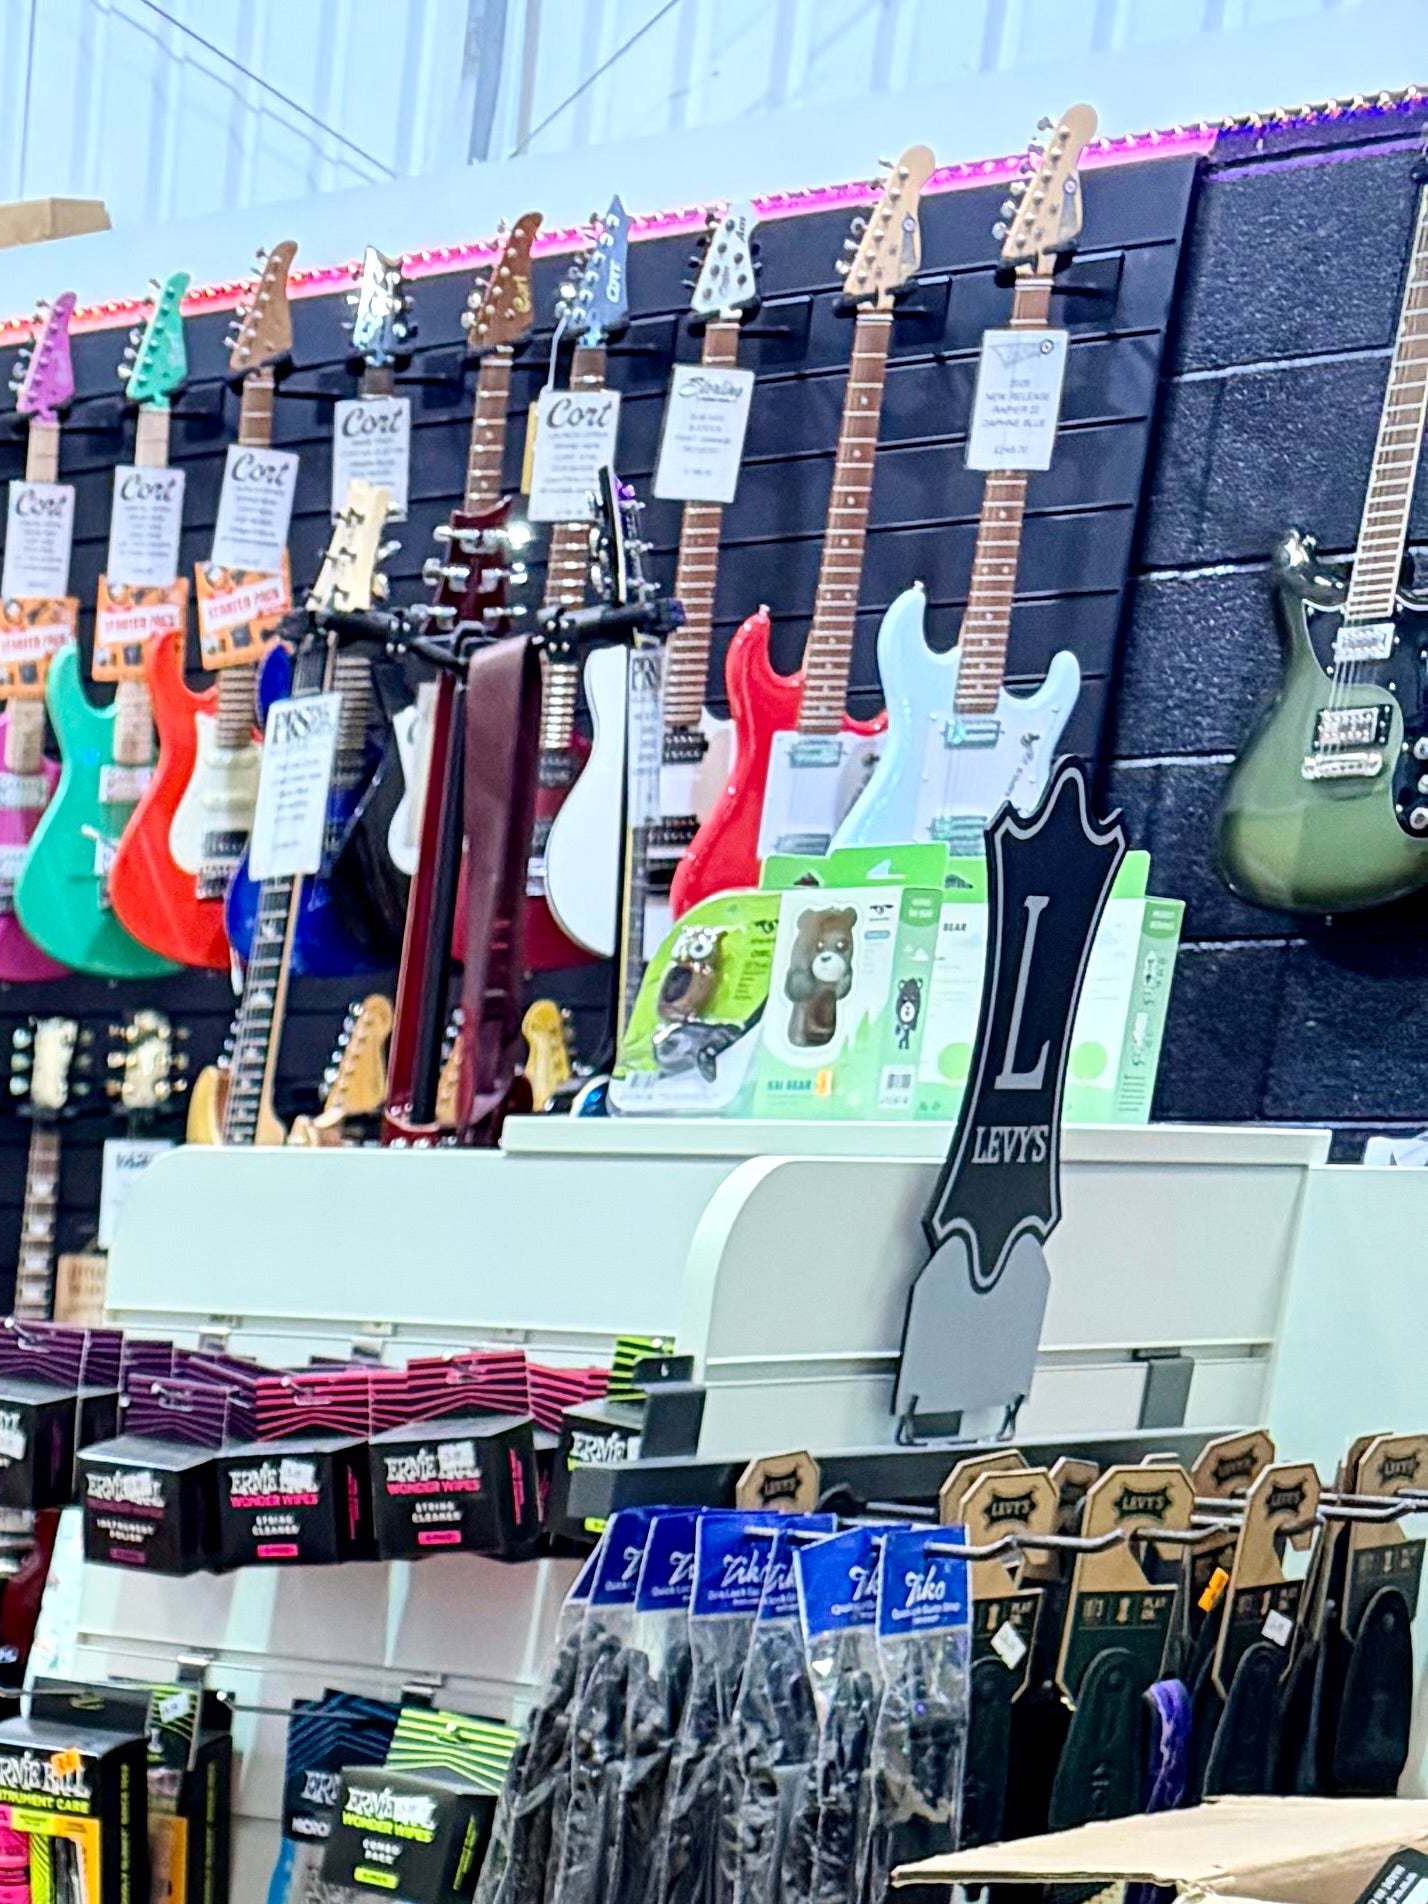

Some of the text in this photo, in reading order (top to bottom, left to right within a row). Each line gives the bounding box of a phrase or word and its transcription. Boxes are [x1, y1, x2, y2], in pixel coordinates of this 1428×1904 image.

[341, 406, 404, 438] Cort
[547, 397, 613, 430] Cort
[231, 453, 291, 487] Cort
[14, 488, 68, 518] Cort
[120, 473, 178, 502] Cort
[994, 895, 1051, 1091] L
[972, 1124, 1049, 1165] LEVY'S
[571, 1431, 628, 1463] ERNIE
[229, 1461, 279, 1495] ERNIE
[384, 1447, 438, 1482] ERNIE
